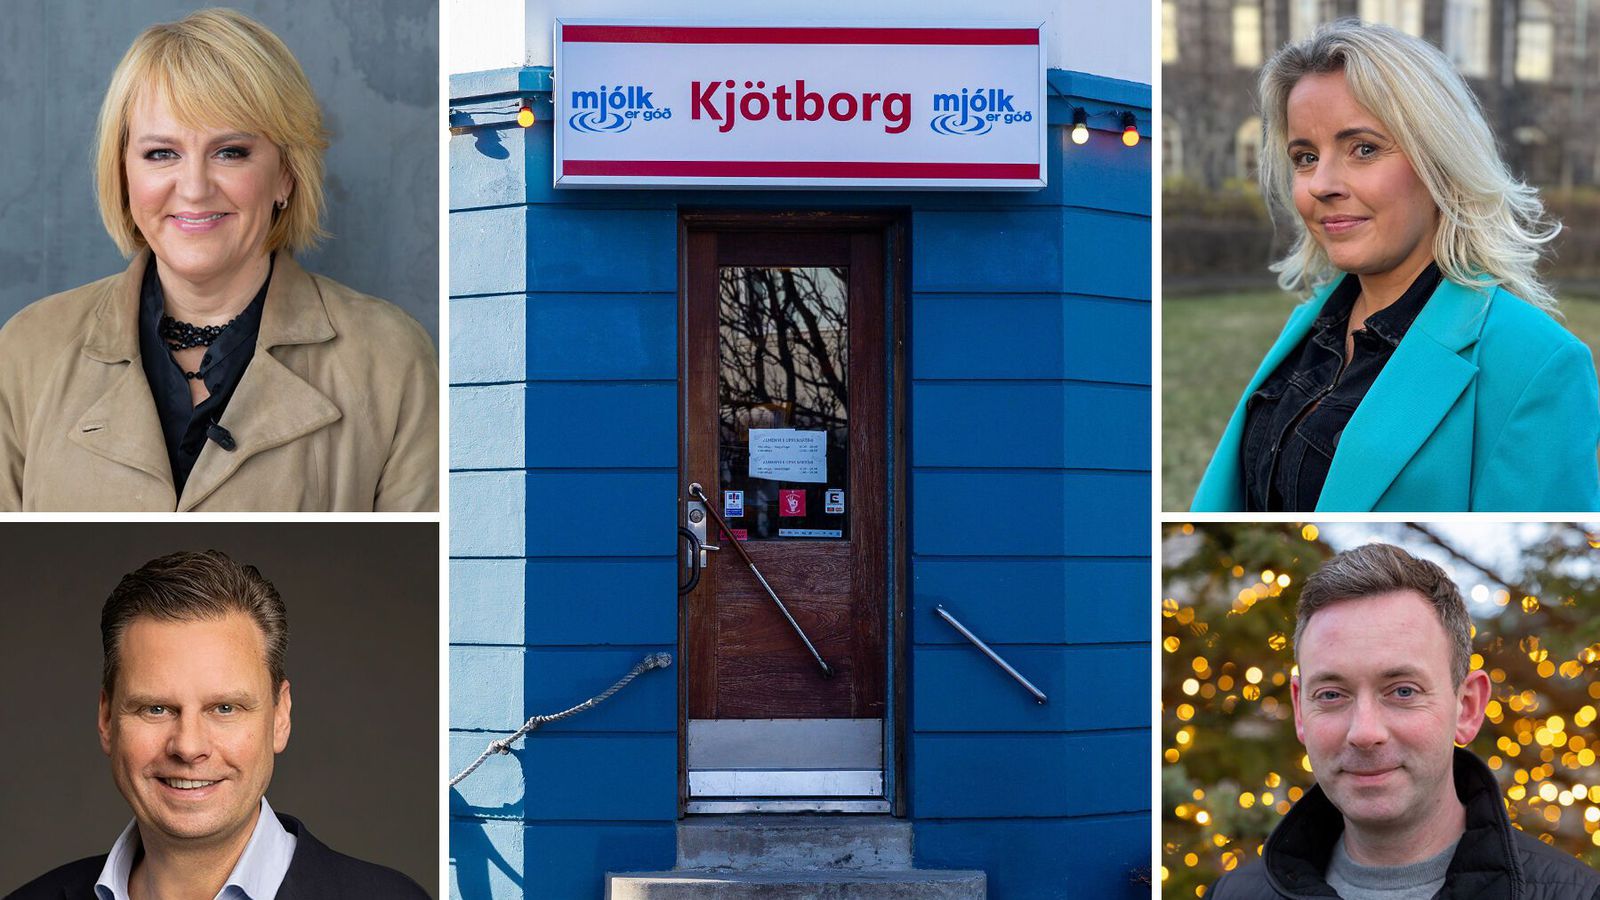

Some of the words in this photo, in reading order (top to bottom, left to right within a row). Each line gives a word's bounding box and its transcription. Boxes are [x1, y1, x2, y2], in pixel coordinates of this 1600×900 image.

[572, 85, 654, 124] mjólk
[624, 110, 640, 119] er
[643, 107, 672, 121] góð
[691, 79, 912, 134] Kjötborg
[933, 88, 1015, 126] mjólk
[985, 113, 1001, 122] er
[1004, 111, 1033, 124] góð
